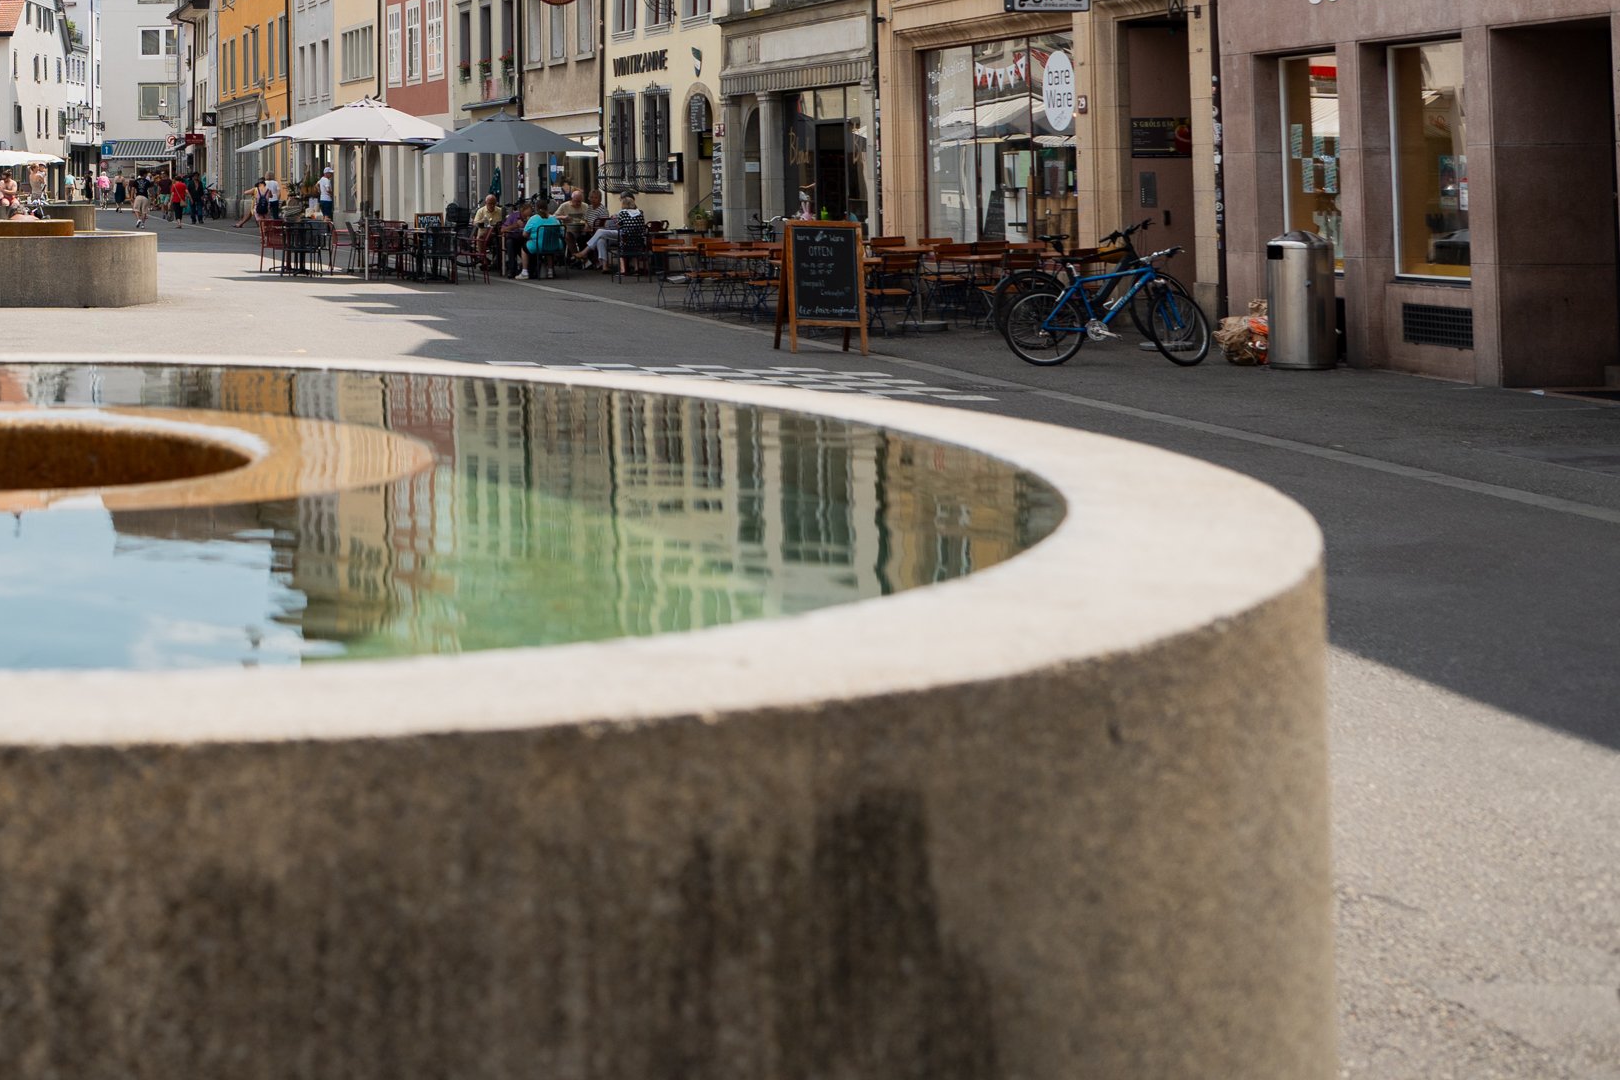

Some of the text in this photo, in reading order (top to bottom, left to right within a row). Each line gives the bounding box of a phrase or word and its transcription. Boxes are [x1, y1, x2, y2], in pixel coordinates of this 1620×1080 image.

[612, 48, 669, 78] WINTIKANNE
[1047, 65, 1071, 87] bare
[1045, 90, 1073, 108] Ware
